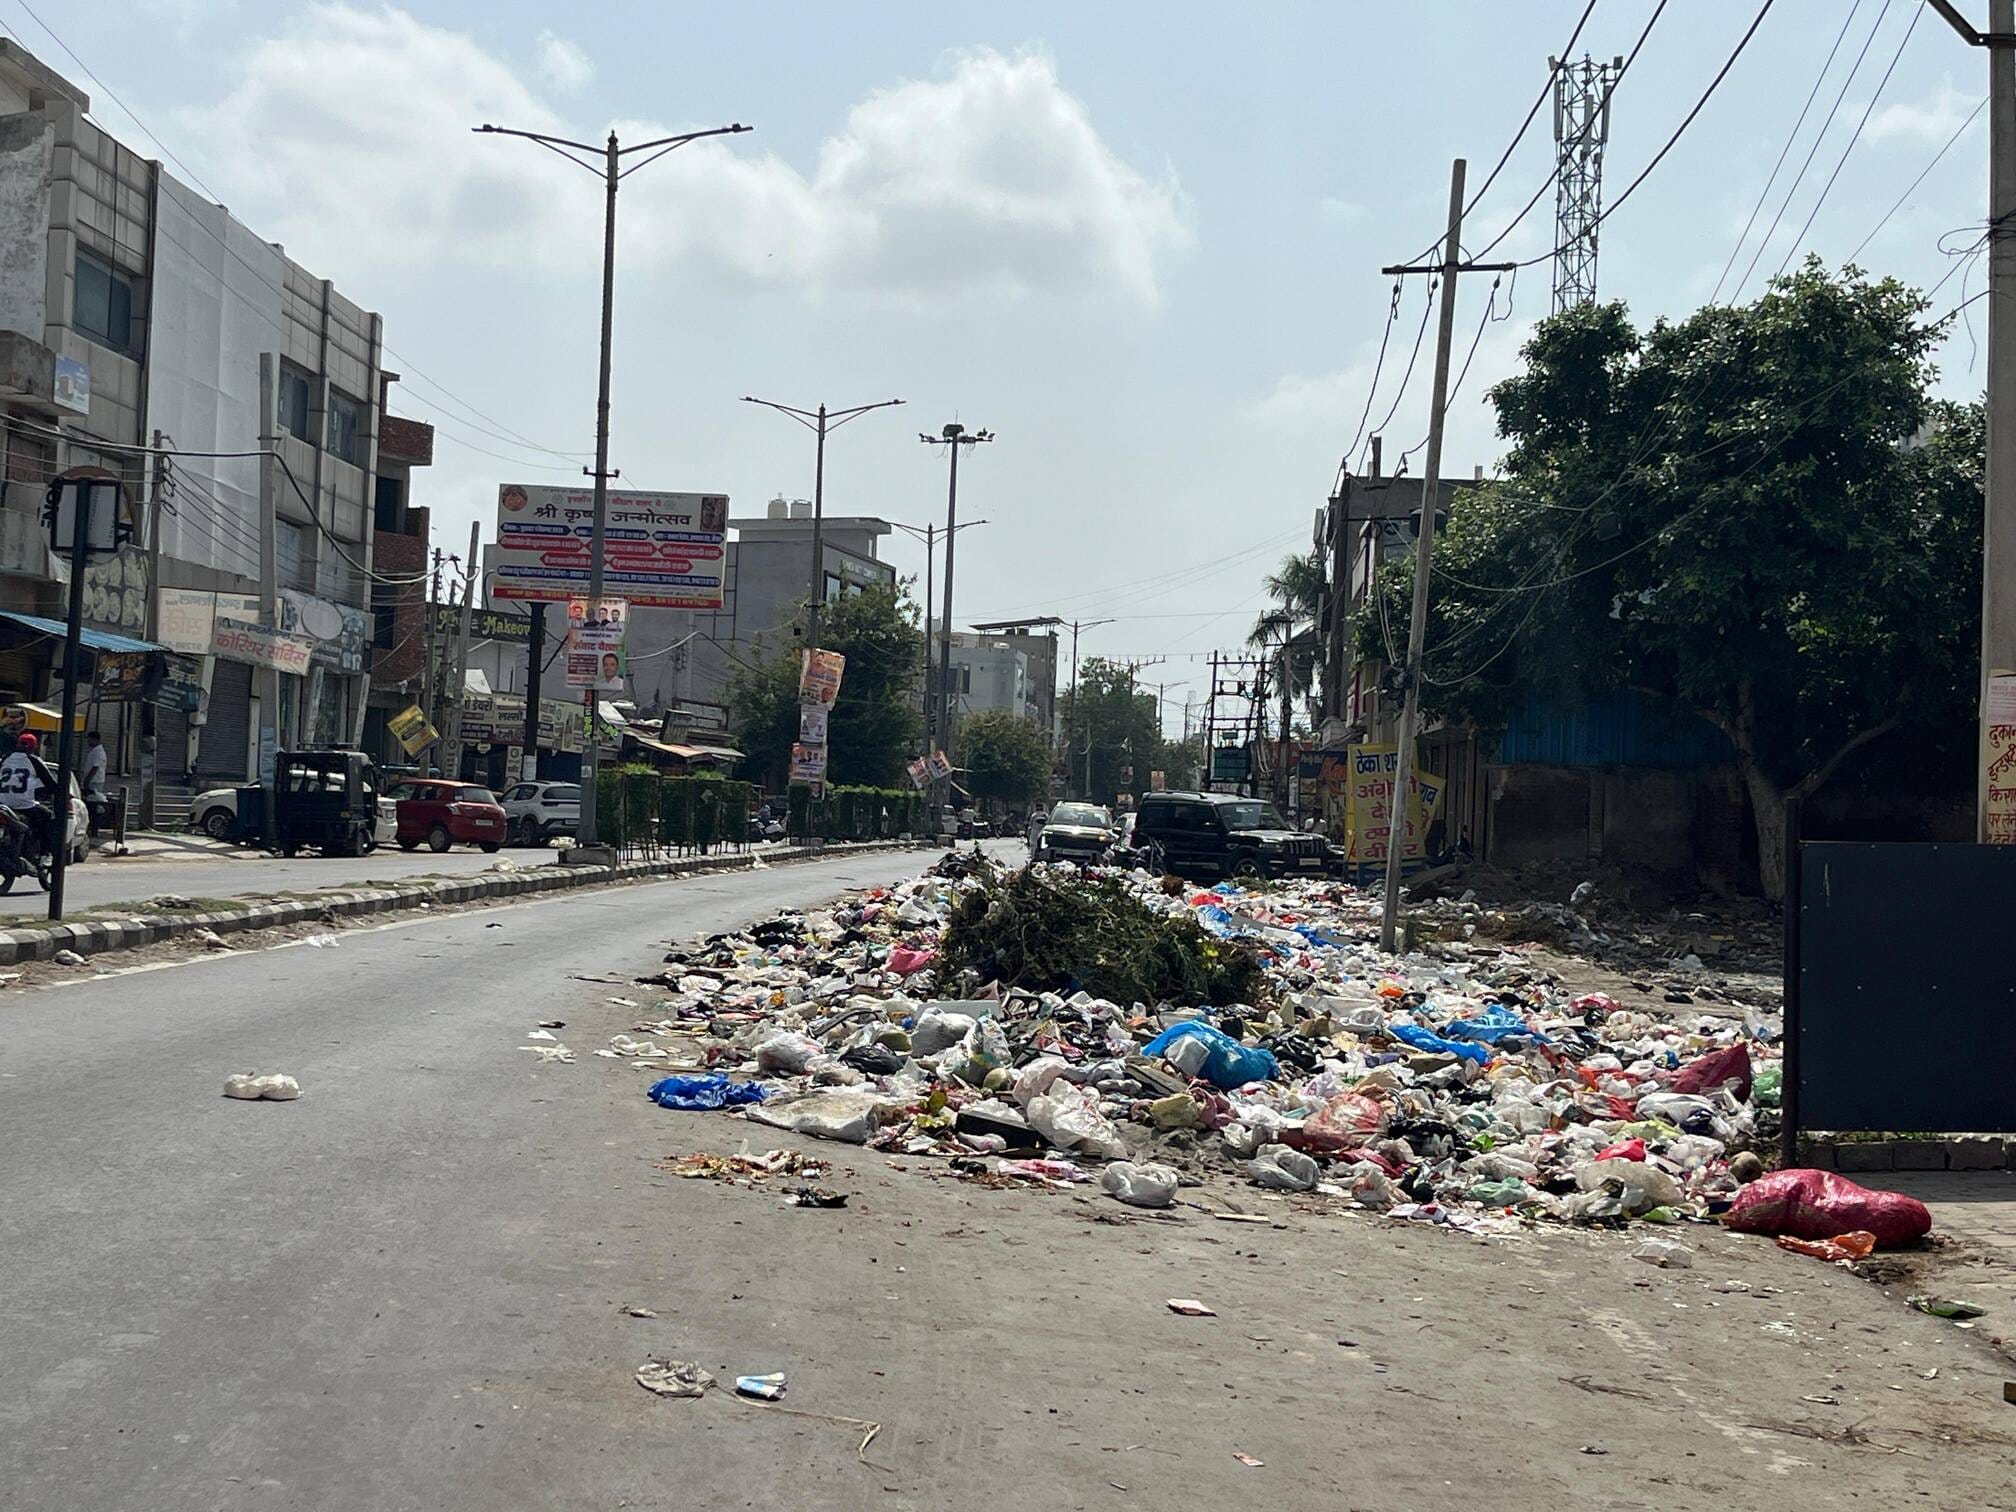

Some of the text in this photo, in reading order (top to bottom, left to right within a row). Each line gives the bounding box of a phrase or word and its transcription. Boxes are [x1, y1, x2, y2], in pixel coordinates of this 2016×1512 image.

[533, 503, 559, 518] श्री
[610, 508, 692, 525] जन्मोत्सव
[1355, 749, 1380, 774] ठेका
[0, 767, 30, 793] 23
